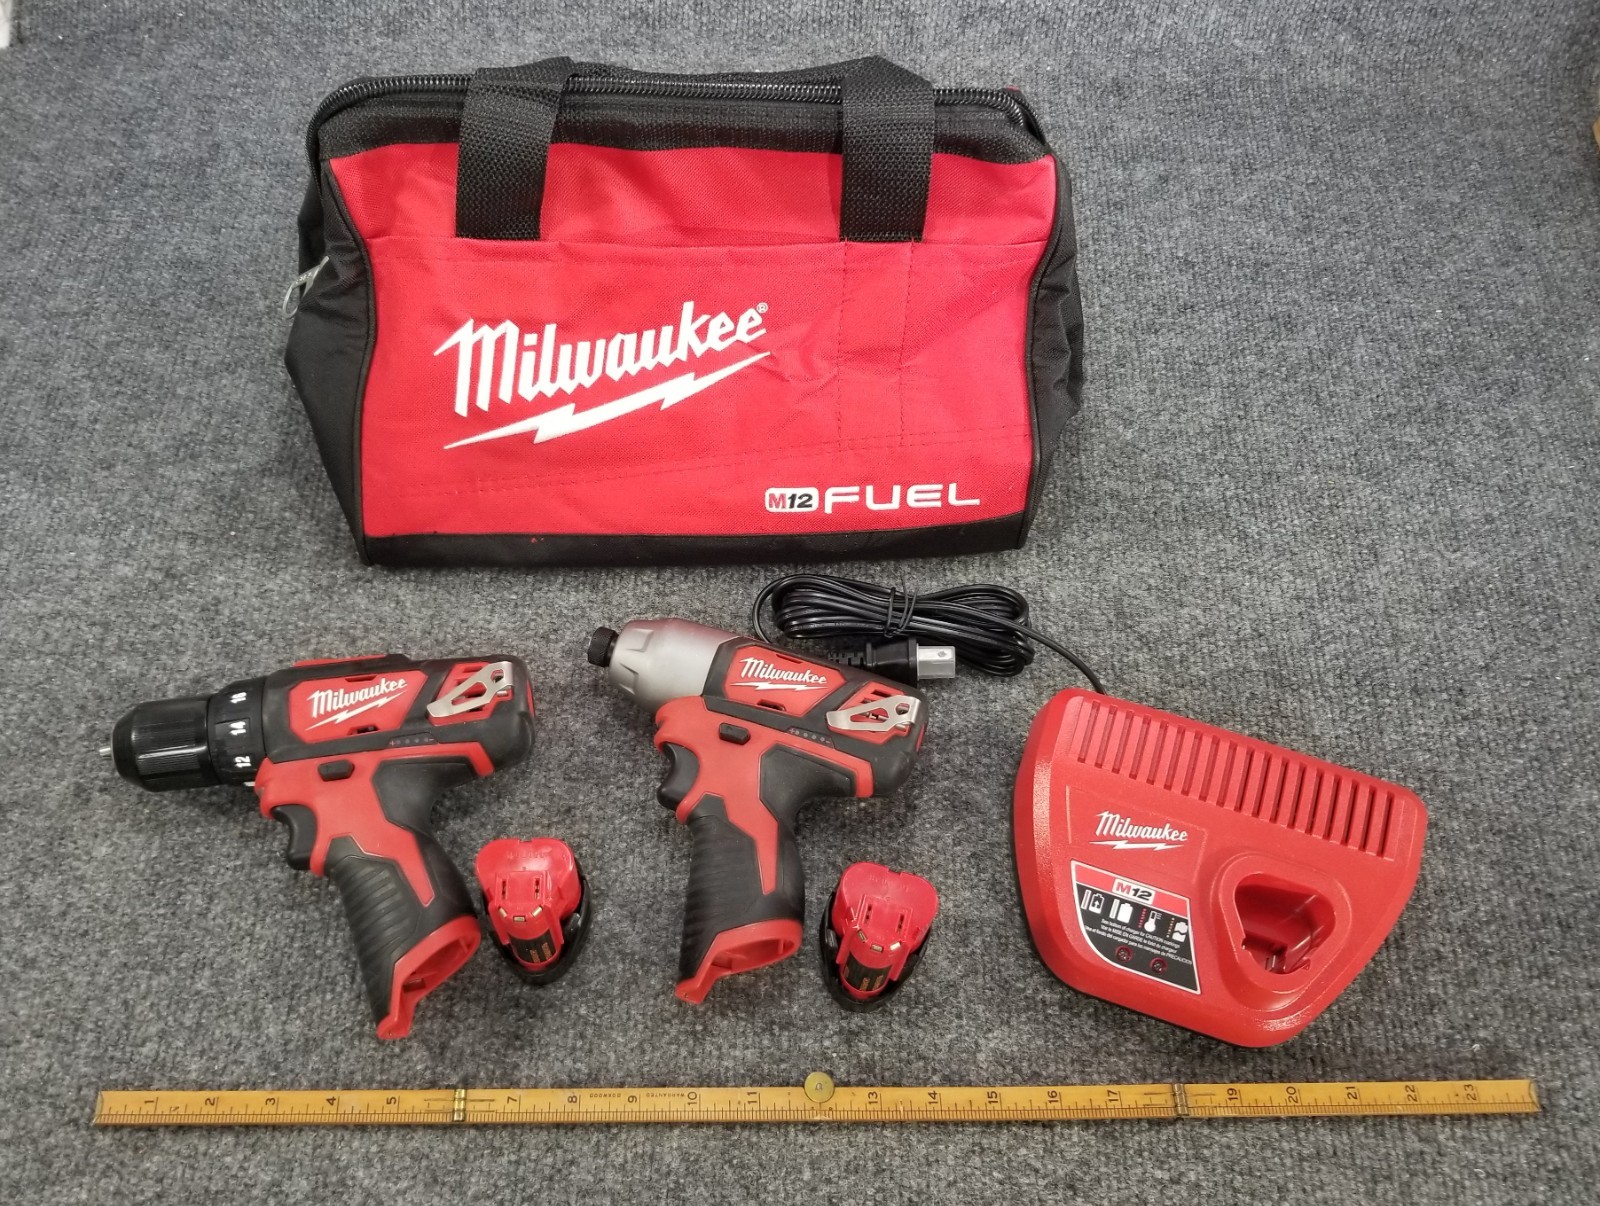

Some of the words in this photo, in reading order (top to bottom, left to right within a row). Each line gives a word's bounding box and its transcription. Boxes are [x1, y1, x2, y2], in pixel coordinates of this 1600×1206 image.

[768, 493, 813, 509] M12
[824, 484, 980, 513] FUEL
[739, 657, 827, 686] Milwaukee
[306, 678, 408, 718] Milwaukee
[229, 721, 246, 735] 14
[234, 756, 252, 768] 12
[1096, 810, 1188, 842] Milwaukee
[1115, 881, 1153, 901] M12
[507, 1095, 518, 1104] 7
[567, 1095, 578, 1103] 8
[628, 1095, 637, 1103] 9
[687, 1091, 698, 1106] 10
[747, 1091, 758, 1104] 11
[868, 1091, 879, 1105] 13
[928, 1091, 938, 1104] 14
[988, 1090, 998, 1105] 15
[1048, 1090, 1059, 1104] 16
[1108, 1089, 1118, 1102] 17
[1227, 1088, 1237, 1102] 19
[1288, 1086, 1298, 1103] 20
[1347, 1085, 1358, 1100] 21
[1406, 1084, 1418, 1102] 22
[1465, 1084, 1477, 1101] 23
[205, 1097, 216, 1106] 2
[265, 1097, 276, 1105] 3
[326, 1096, 337, 1106] 4
[386, 1096, 397, 1105] 5
